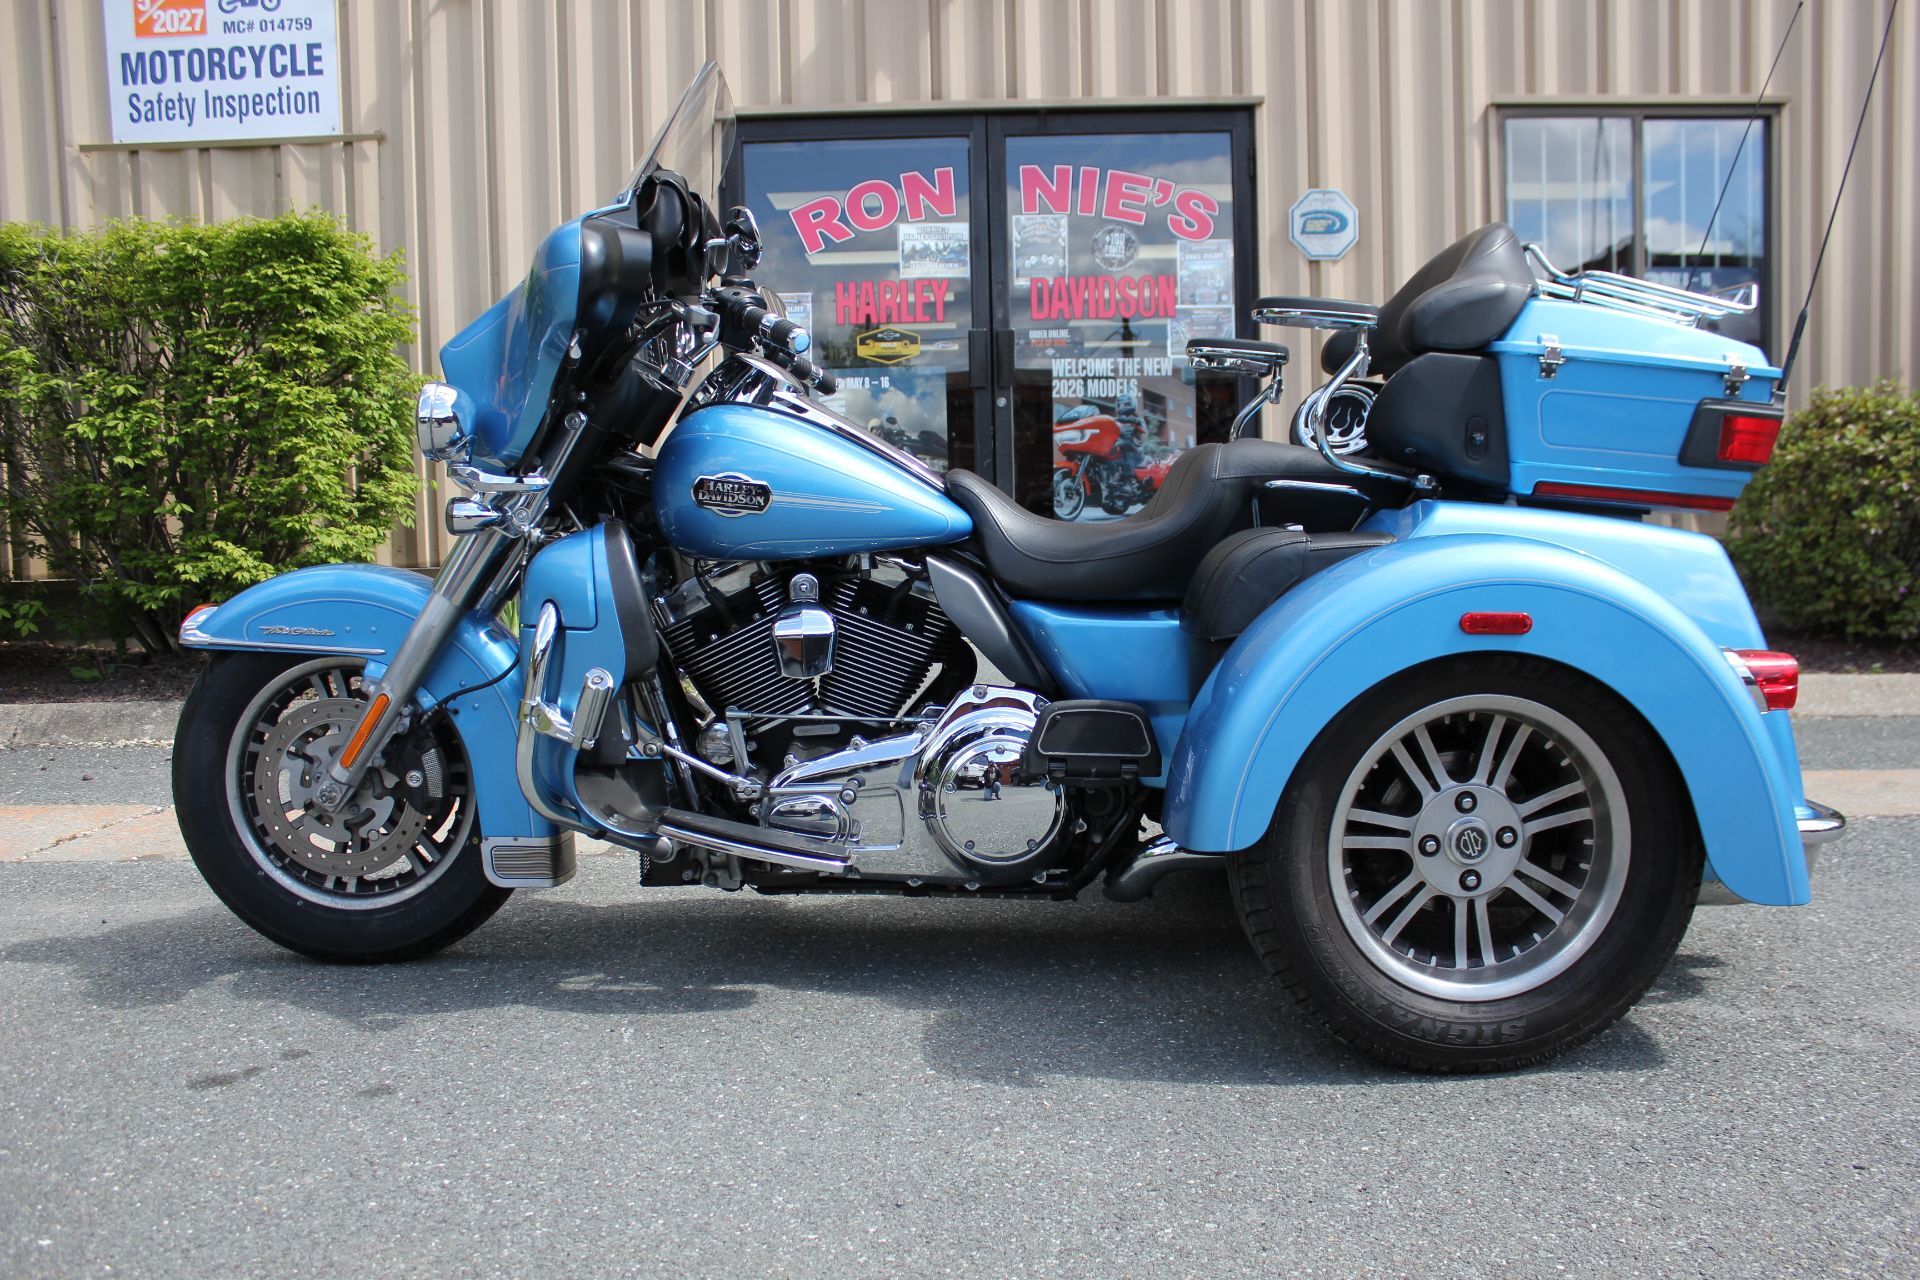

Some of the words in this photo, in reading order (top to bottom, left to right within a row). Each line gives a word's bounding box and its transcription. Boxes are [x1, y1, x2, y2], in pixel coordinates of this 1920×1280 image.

[223, 20, 255, 34] MC#
[259, 17, 313, 33] 014759
[121, 42, 324, 86] MOTORCYCLE
[128, 92, 196, 127] Safety
[204, 85, 321, 124] Inspection
[788, 167, 957, 254] RON
[834, 279, 950, 326] HARLEY
[1030, 274, 1177, 321] DAVIDSON
[1029, 330, 1048, 339] ORDER
[1052, 357, 1114, 378] WELCOME
[1117, 357, 1142, 377] THE
[1144, 356, 1173, 377] NEW
[846, 377, 864, 389] MAY
[864, 377, 870, 389] 8
[881, 375, 890, 388] 16
[1052, 378, 1084, 399] 2026
[1087, 378, 1142, 399] MODELS.
[698, 490, 765, 505] DAVIDSON
